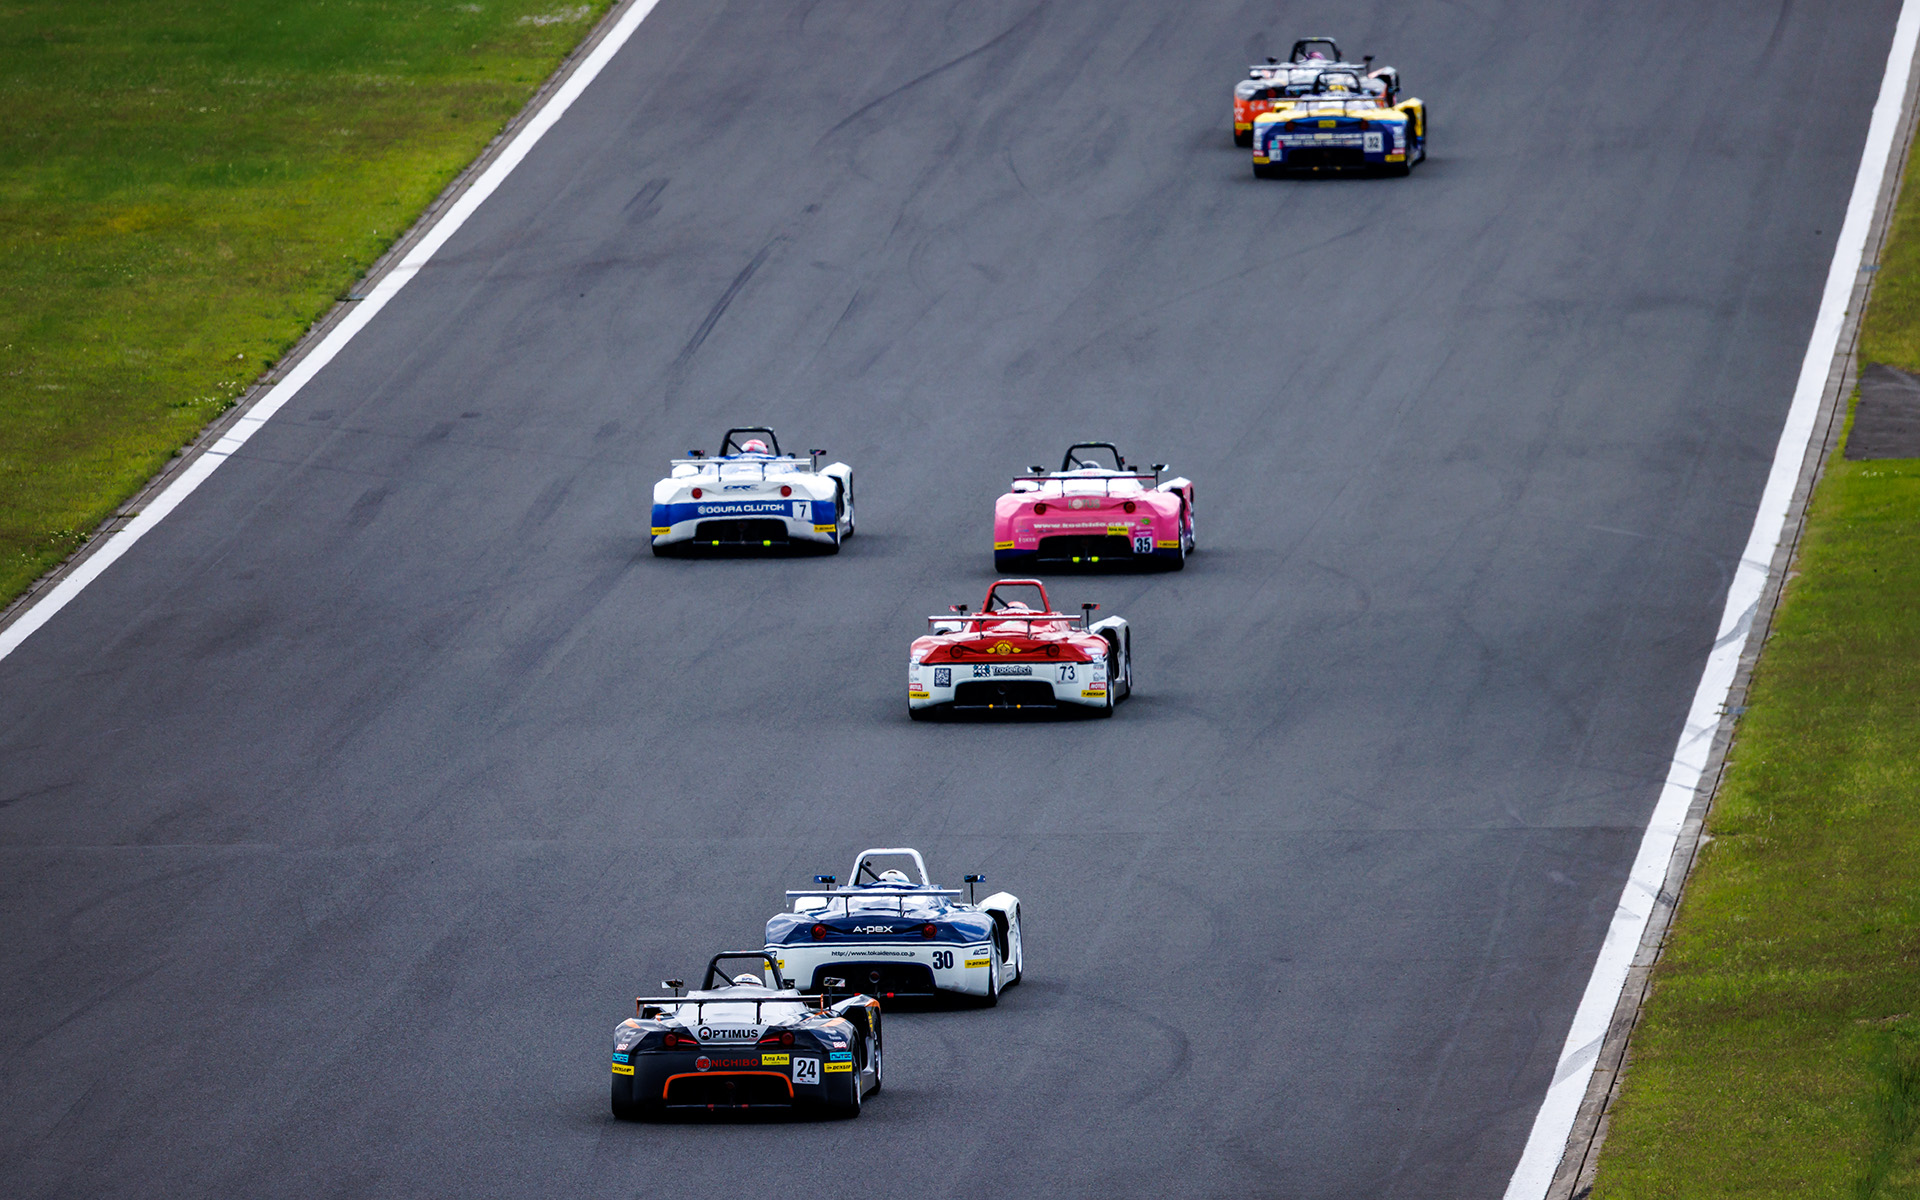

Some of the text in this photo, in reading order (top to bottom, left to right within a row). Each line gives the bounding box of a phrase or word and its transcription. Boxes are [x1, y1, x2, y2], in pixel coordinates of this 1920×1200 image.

[706, 504, 785, 514] OGURA CLUTCH
[799, 504, 807, 518] 7
[1068, 499, 1101, 510] LOTUS
[1136, 537, 1151, 553] 35
[1059, 665, 1076, 681] 73
[831, 950, 916, 958] http://www.tokaidenso.co.jp
[932, 950, 955, 970] 30
[698, 1026, 759, 1041] OPTIMUS
[711, 1058, 759, 1068] NICHIBO
[796, 1059, 817, 1079] 24
